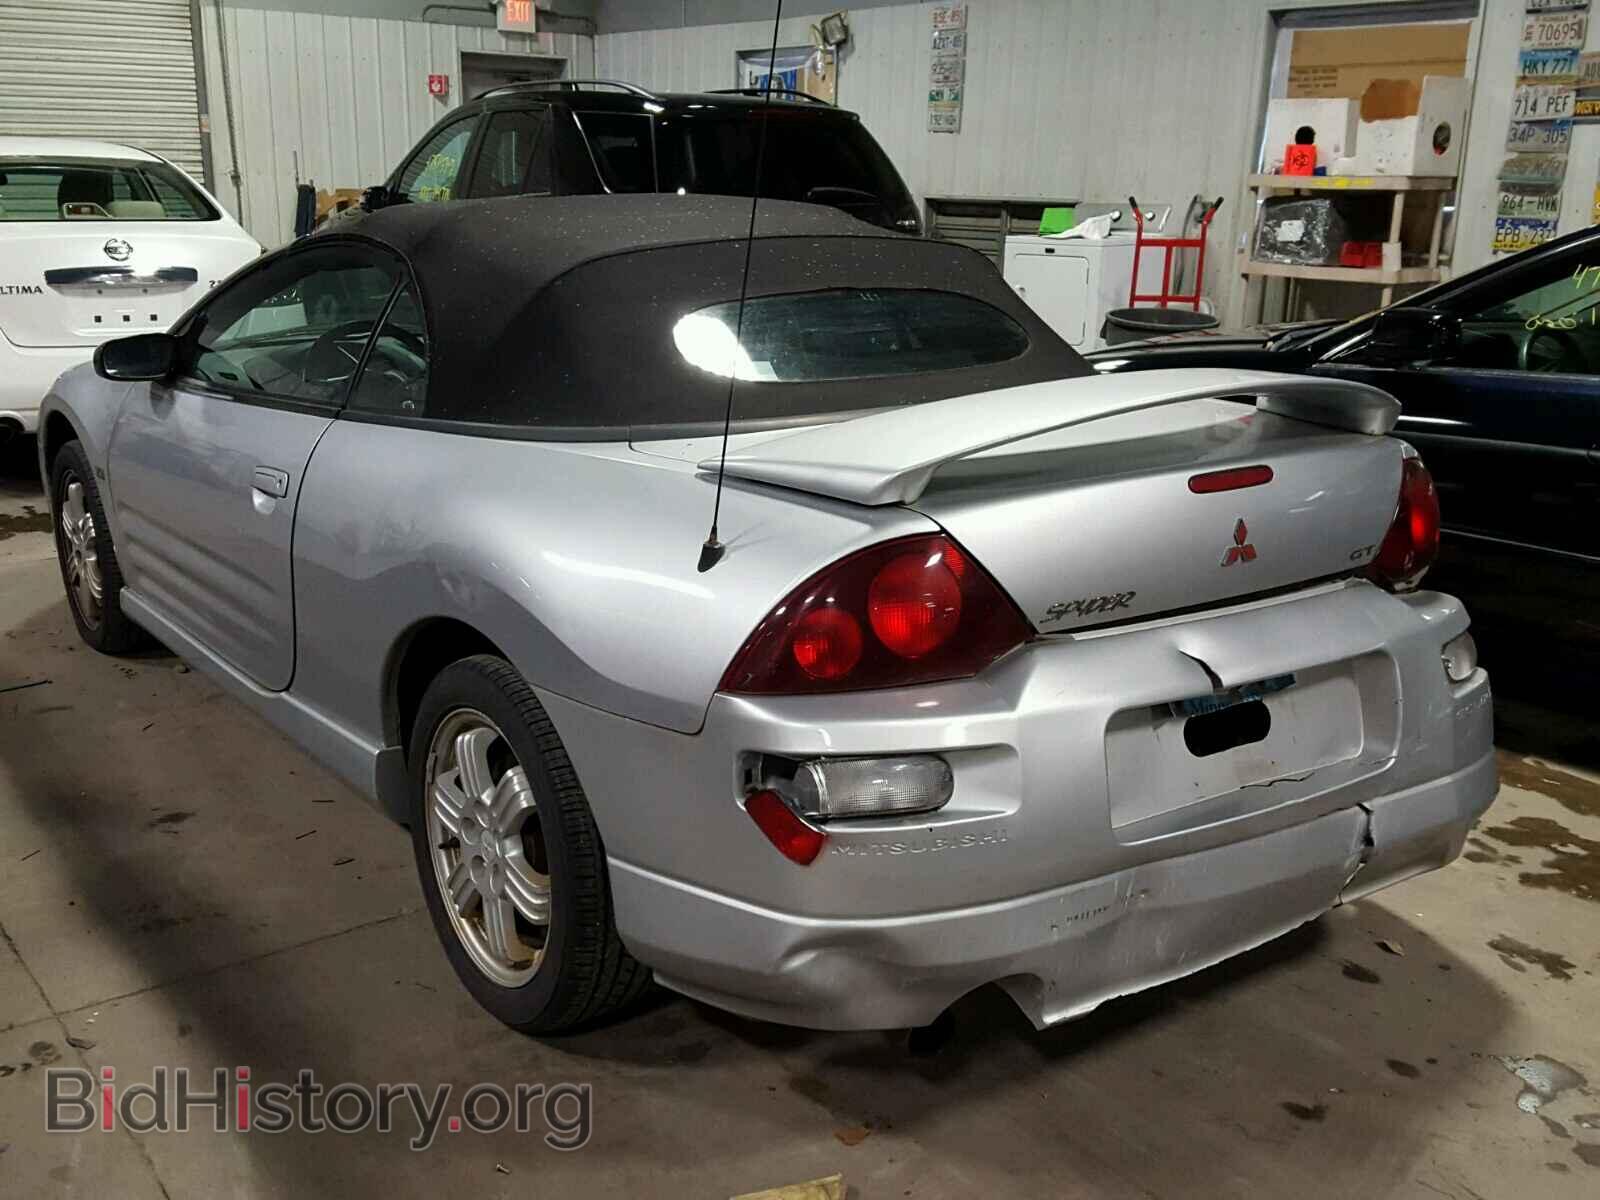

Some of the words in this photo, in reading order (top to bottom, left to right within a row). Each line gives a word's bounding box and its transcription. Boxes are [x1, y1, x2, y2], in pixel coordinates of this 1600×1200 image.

[505, 0, 530, 23] EXIT
[1522, 59, 1548, 76] HKY
[1514, 96, 1538, 116] 714
[1039, 591, 1136, 624] SPYDER
[831, 829, 1008, 857] MITSUBISHI
